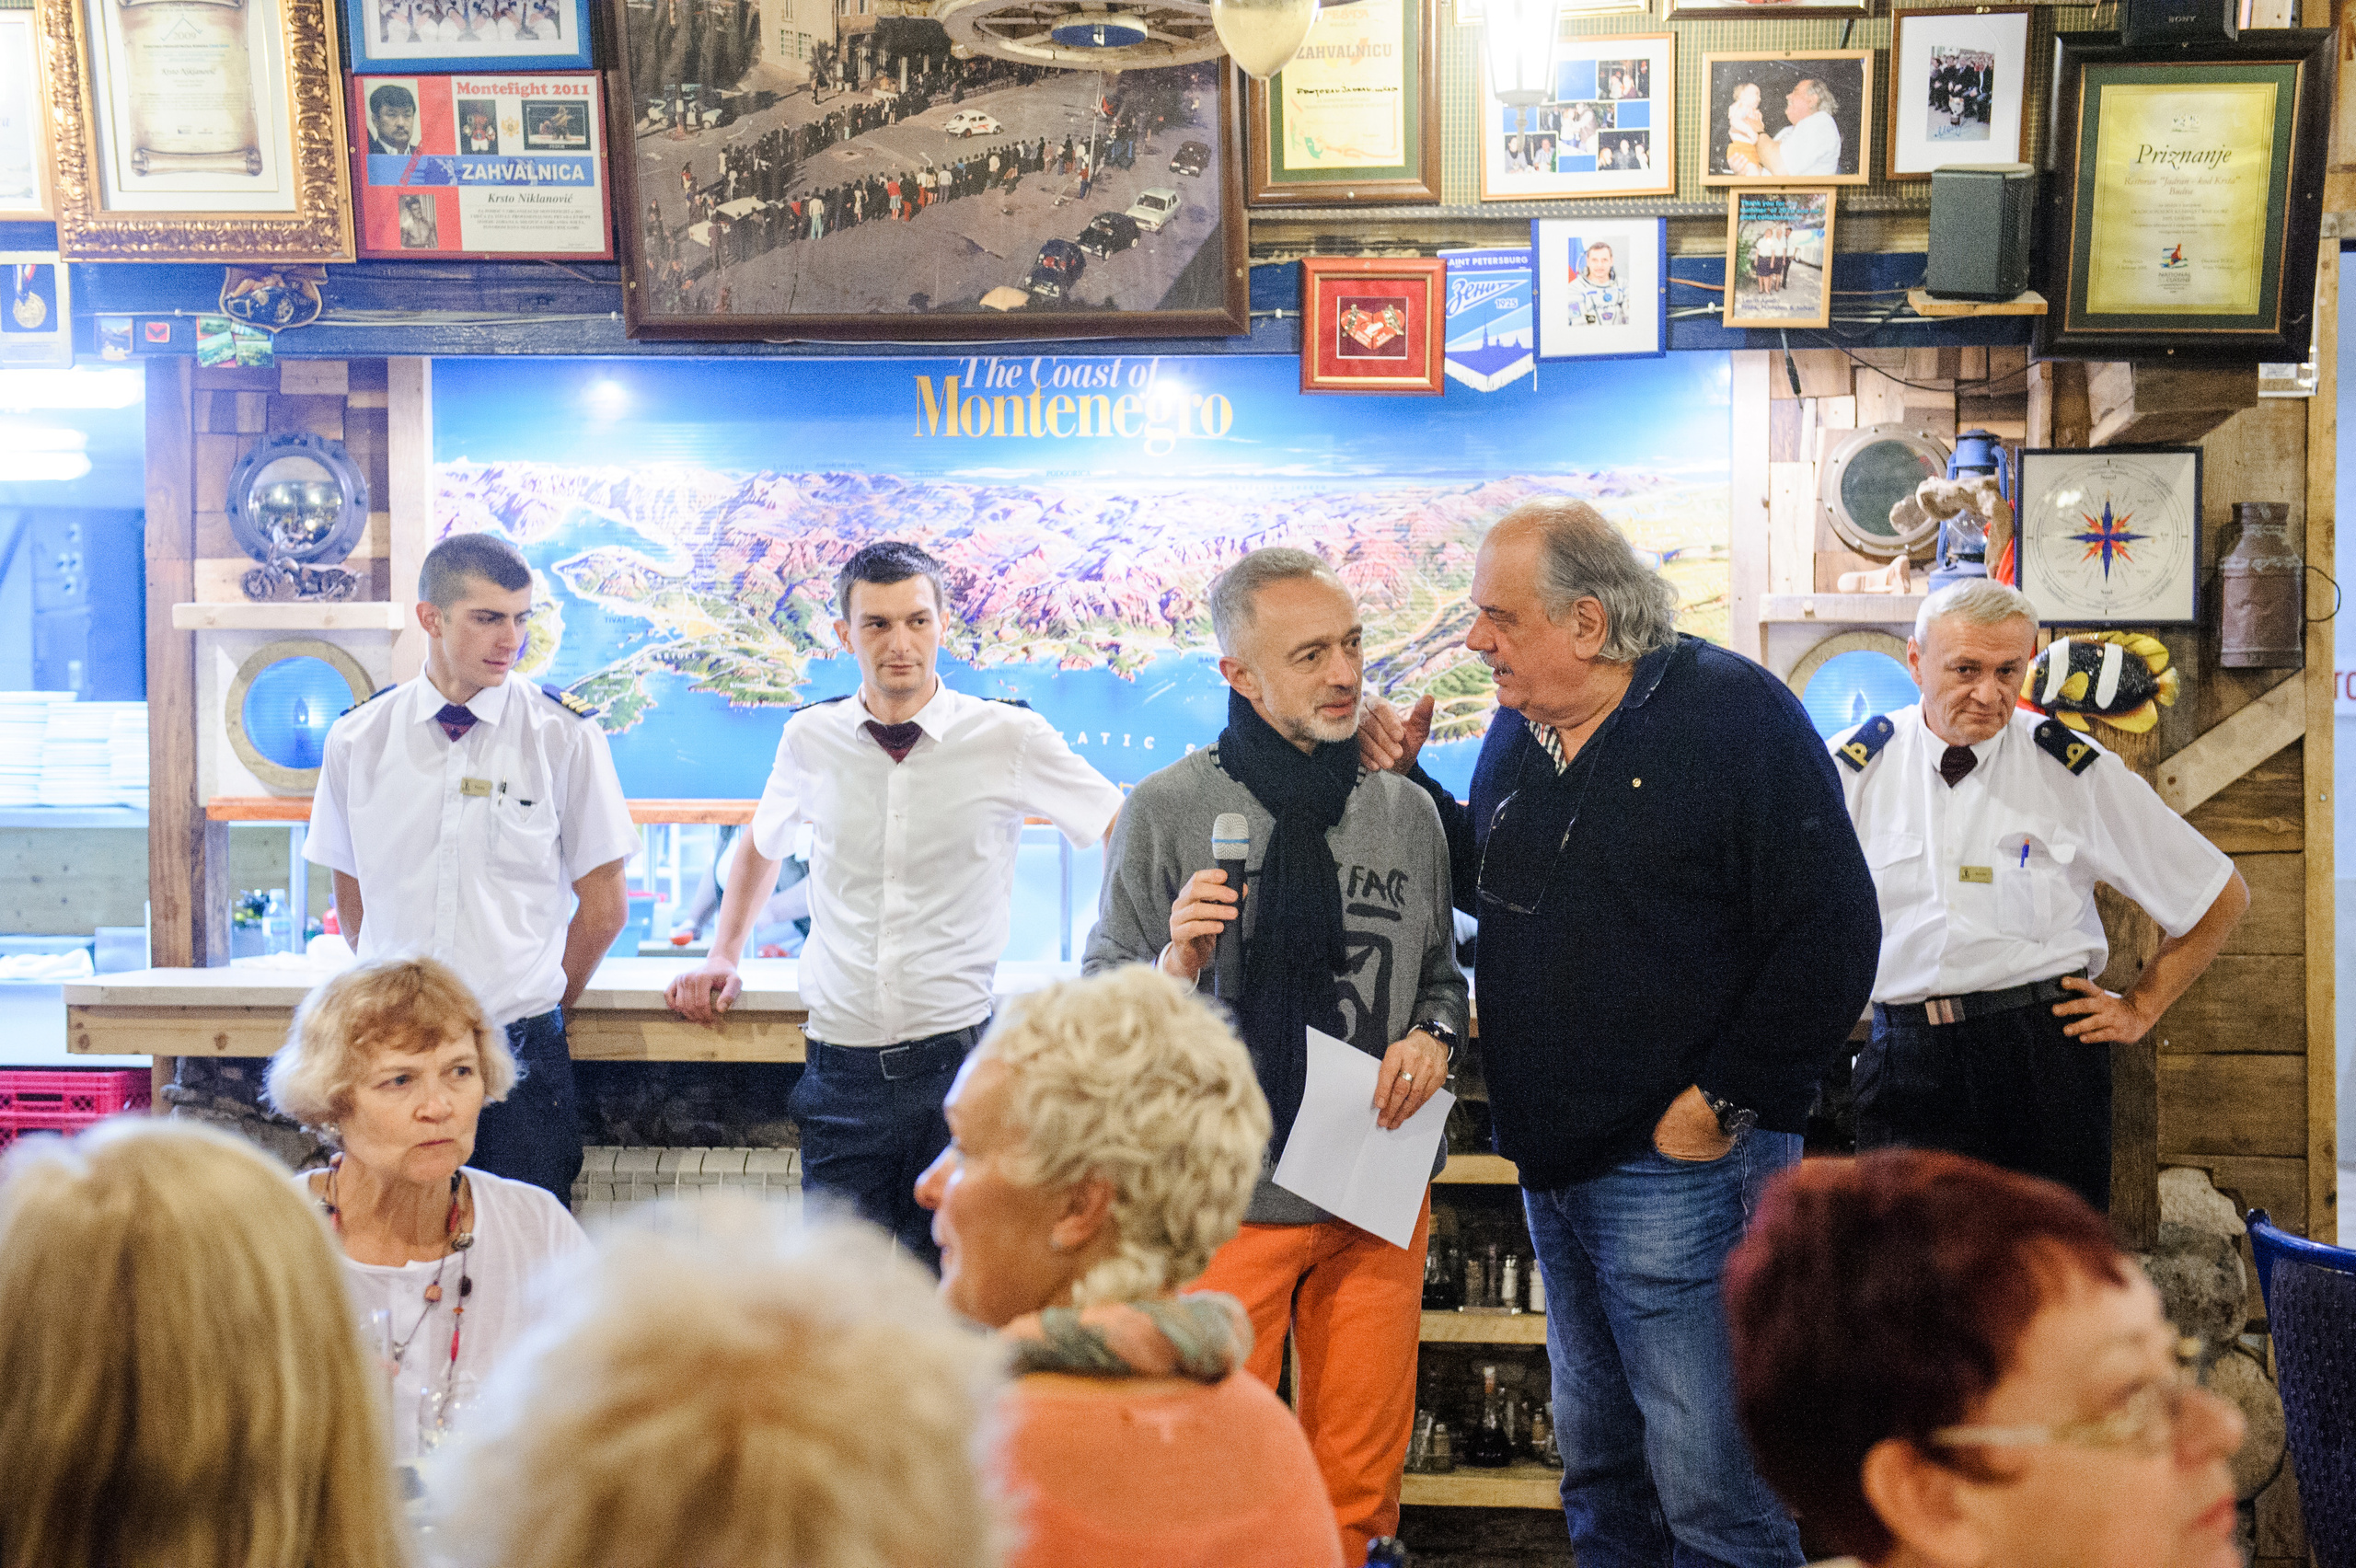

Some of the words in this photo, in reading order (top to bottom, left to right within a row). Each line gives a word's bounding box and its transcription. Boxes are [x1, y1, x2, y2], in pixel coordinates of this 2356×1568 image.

[1296, 43, 1392, 60] ZAHVALNICU
[456, 81, 549, 98] Montefight
[552, 84, 591, 96] 2011
[2134, 143, 2233, 171] Priznanje
[461, 163, 586, 181] ZAHVALNICA
[488, 192, 515, 204] Krsto
[517, 192, 573, 204] Niklanović
[1446, 258, 1471, 266] AINT
[1472, 256, 1529, 266] PETERSBURG
[1496, 299, 1518, 307] 1925
[959, 356, 1023, 388] The
[1029, 356, 1123, 388] Coast
[1128, 356, 1161, 399] of
[913, 375, 1234, 457] Montenegro
[604, 616, 628, 624] TIVAT
[1057, 731, 1156, 750] ATIC
